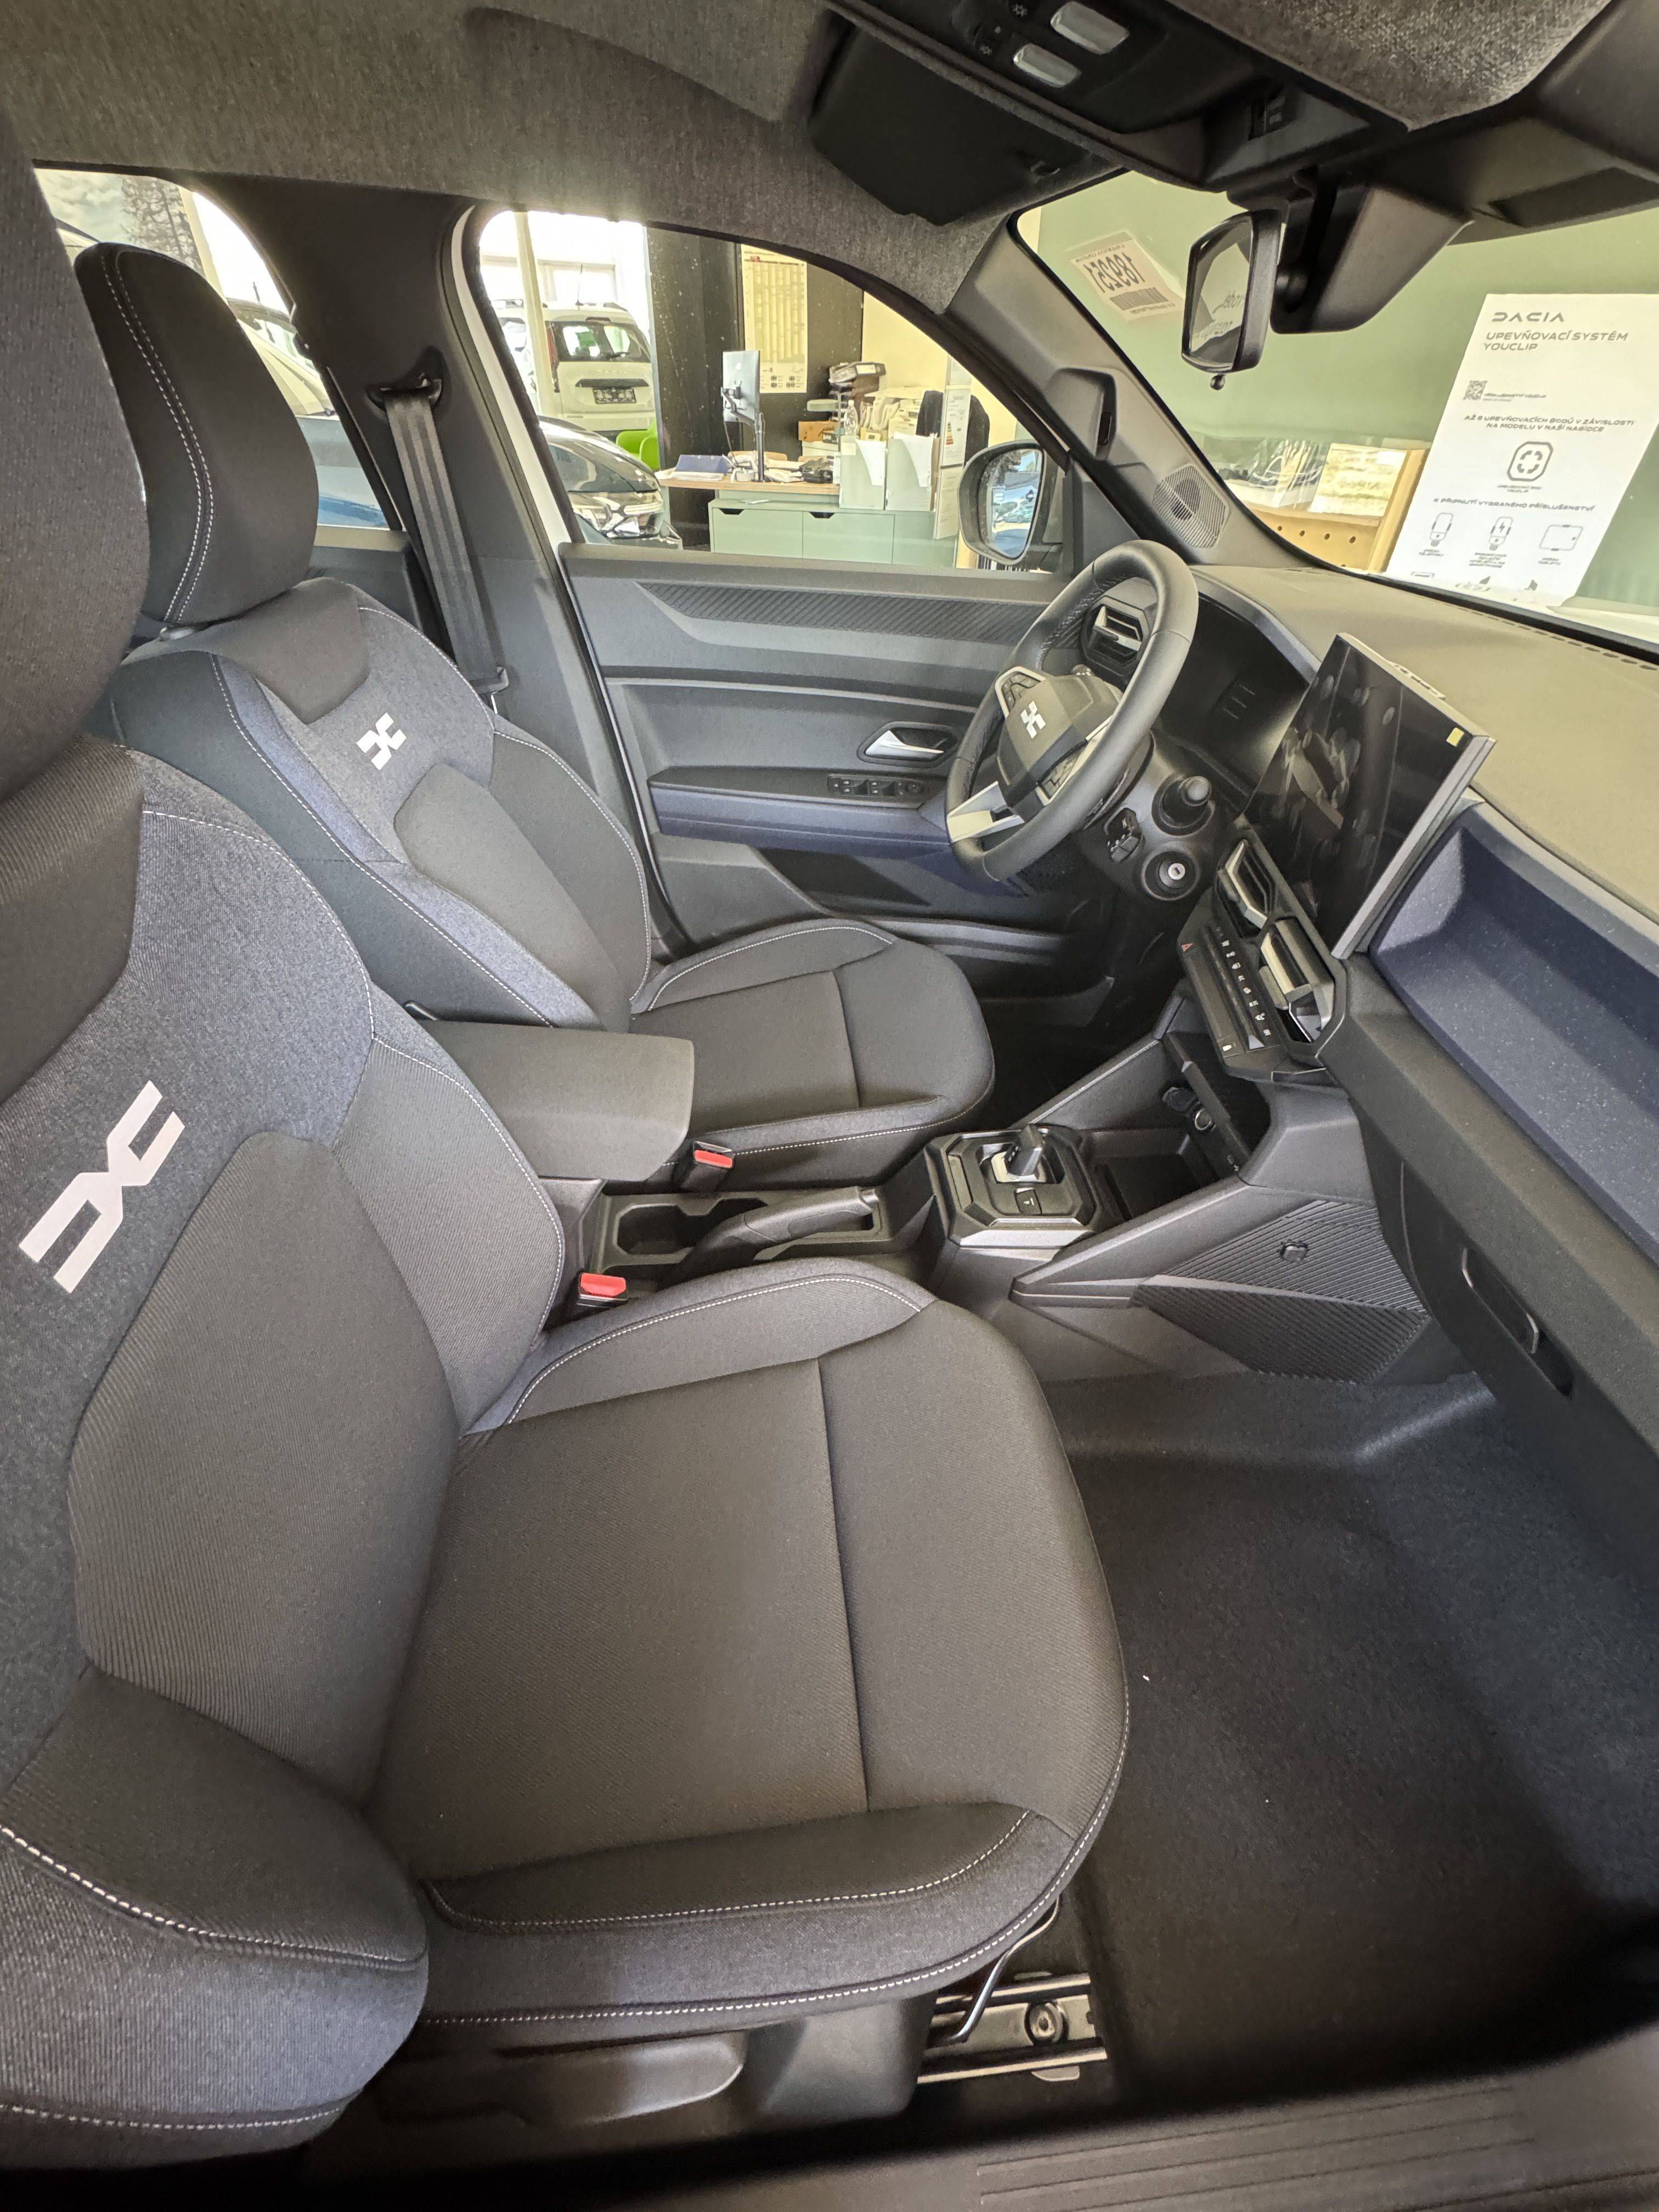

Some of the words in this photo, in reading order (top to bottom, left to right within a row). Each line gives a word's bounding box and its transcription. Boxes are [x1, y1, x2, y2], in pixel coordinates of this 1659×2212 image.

[1492, 312, 1565, 323] DACIA
[1572, 330, 1629, 341] SYSTÉM
[1484, 342, 1538, 351] YOUCLIP
